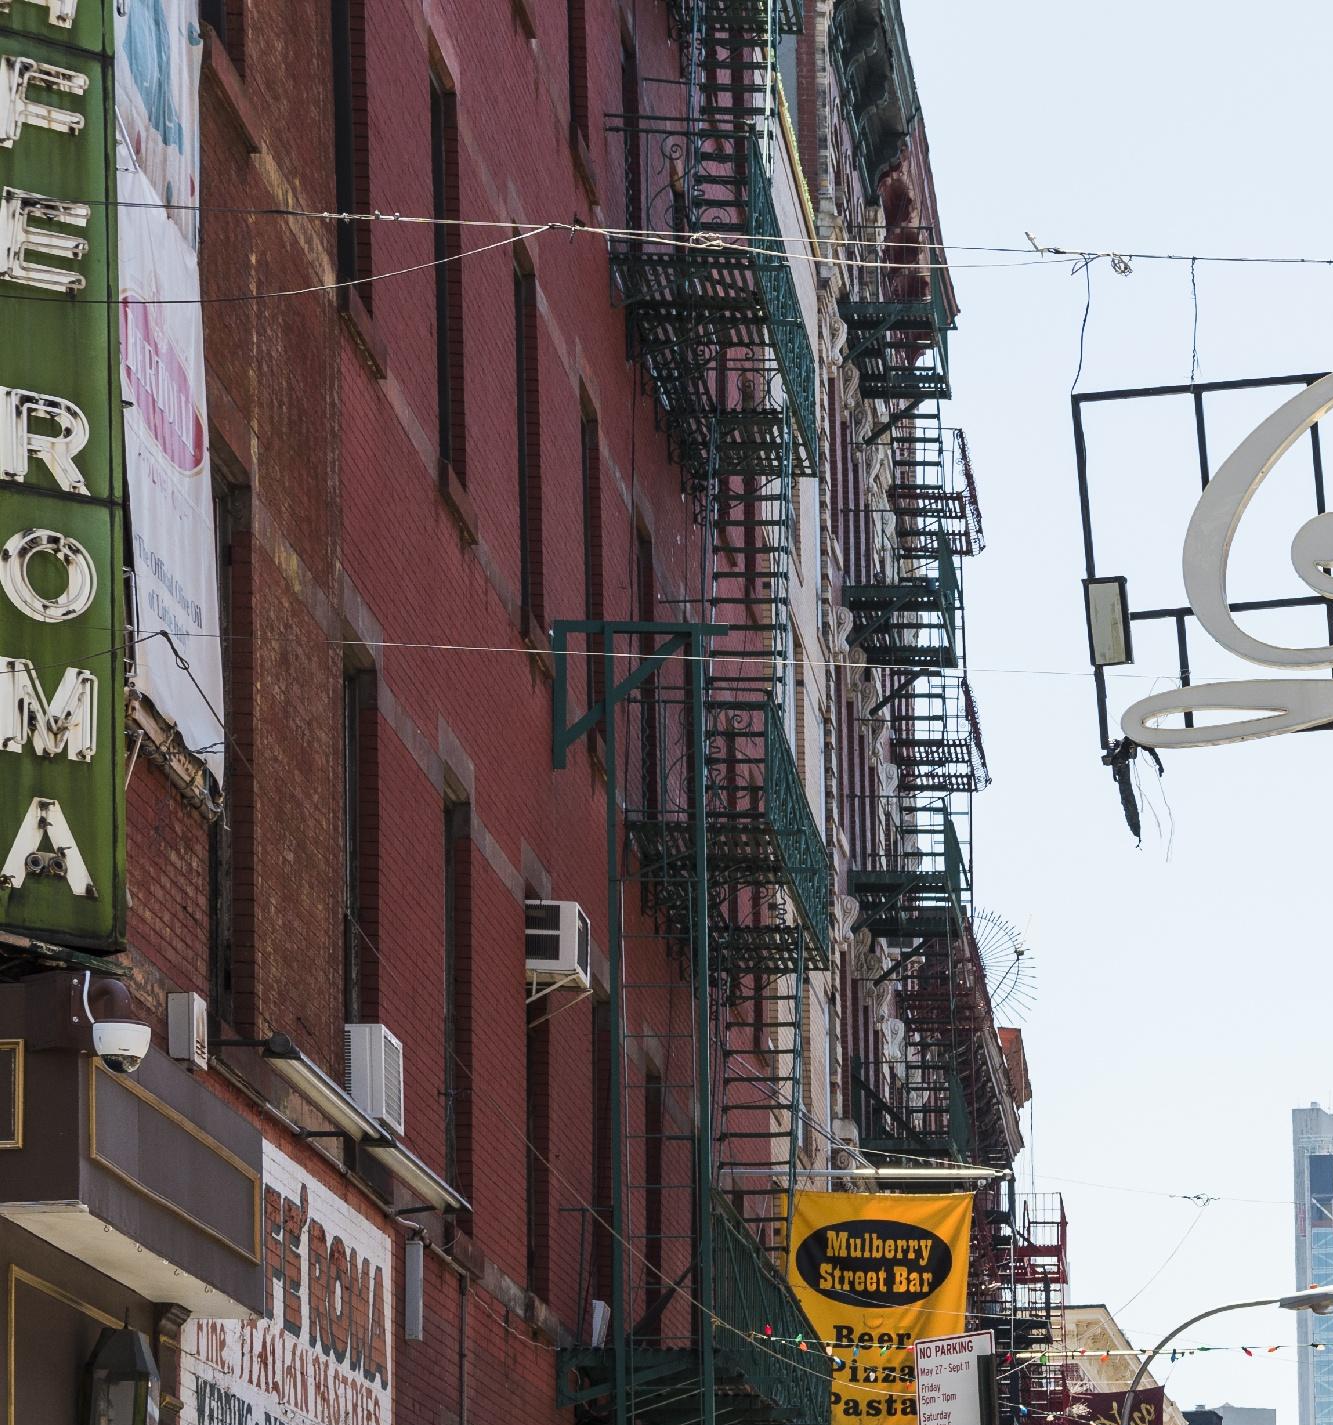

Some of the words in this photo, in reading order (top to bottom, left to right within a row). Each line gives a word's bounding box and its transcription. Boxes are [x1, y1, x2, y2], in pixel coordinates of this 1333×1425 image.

[0, 389, 98, 898] ROMA
[826, 1230, 932, 1265] Mulberry
[819, 1264, 887, 1293] Street
[892, 1267, 933, 1294] Bar
[308, 1217, 389, 1391] ROMA
[833, 1325, 911, 1352] Beer
[919, 1346, 932, 1360] NO
[935, 1340, 973, 1357] PARKING
[920, 1367, 933, 1377] May
[935, 1364, 943, 1375] 27
[948, 1362, 964, 1374] Sept
[921, 1383, 941, 1394] Friday
[942, 1392, 957, 1403] 11pm
[922, 1411, 951, 1423] Saturday
